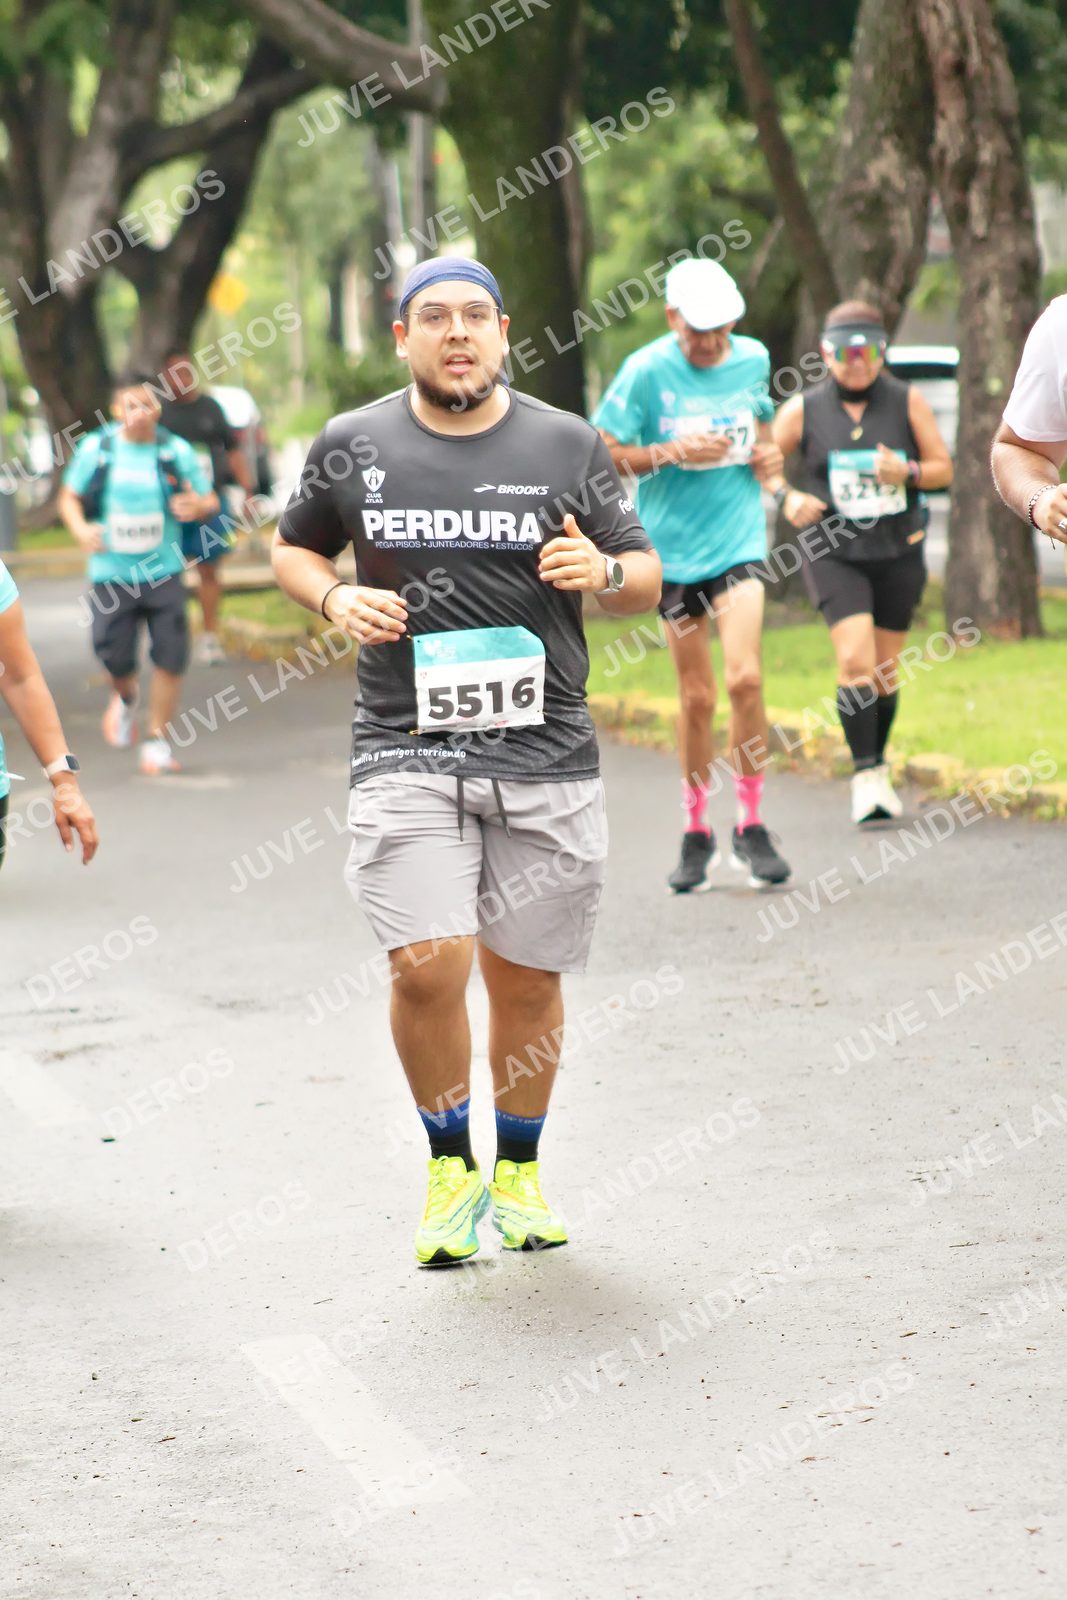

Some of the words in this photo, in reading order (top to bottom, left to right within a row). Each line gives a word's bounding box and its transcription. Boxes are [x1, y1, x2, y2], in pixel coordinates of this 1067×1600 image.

[497, 484, 550, 496] BROOKS
[361, 509, 542, 543] PERDURA
[396, 541, 422, 549] PISOS
[428, 541, 490, 549] JUNTEADORES
[495, 543, 534, 551] ESTUCOS
[428, 676, 536, 721] 5516
[381, 748, 415, 759] amigos
[417, 749, 467, 759] corriendo
